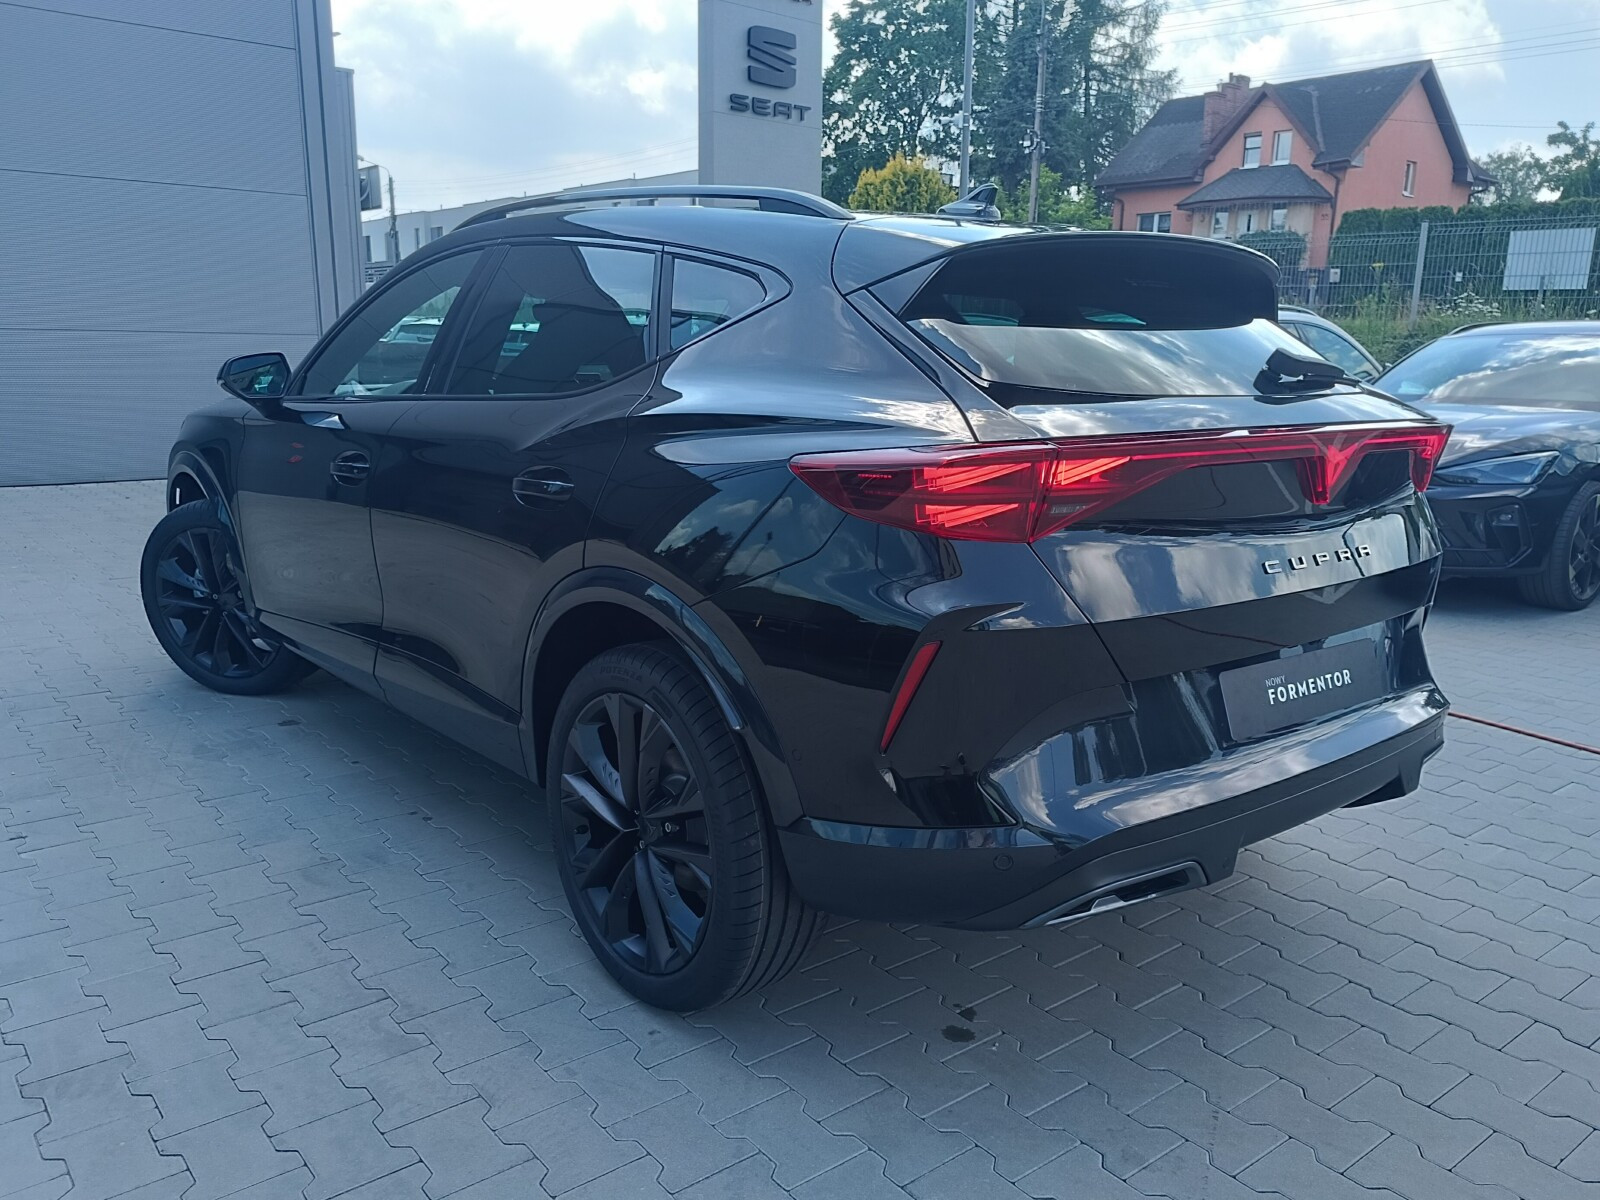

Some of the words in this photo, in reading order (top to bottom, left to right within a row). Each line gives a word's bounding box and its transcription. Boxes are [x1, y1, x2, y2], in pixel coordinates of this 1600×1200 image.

[729, 93, 812, 122] SEAT
[1262, 544, 1372, 575] CUPRA
[1265, 675, 1286, 688] NOWY
[1267, 669, 1352, 705] FORMENTOR
